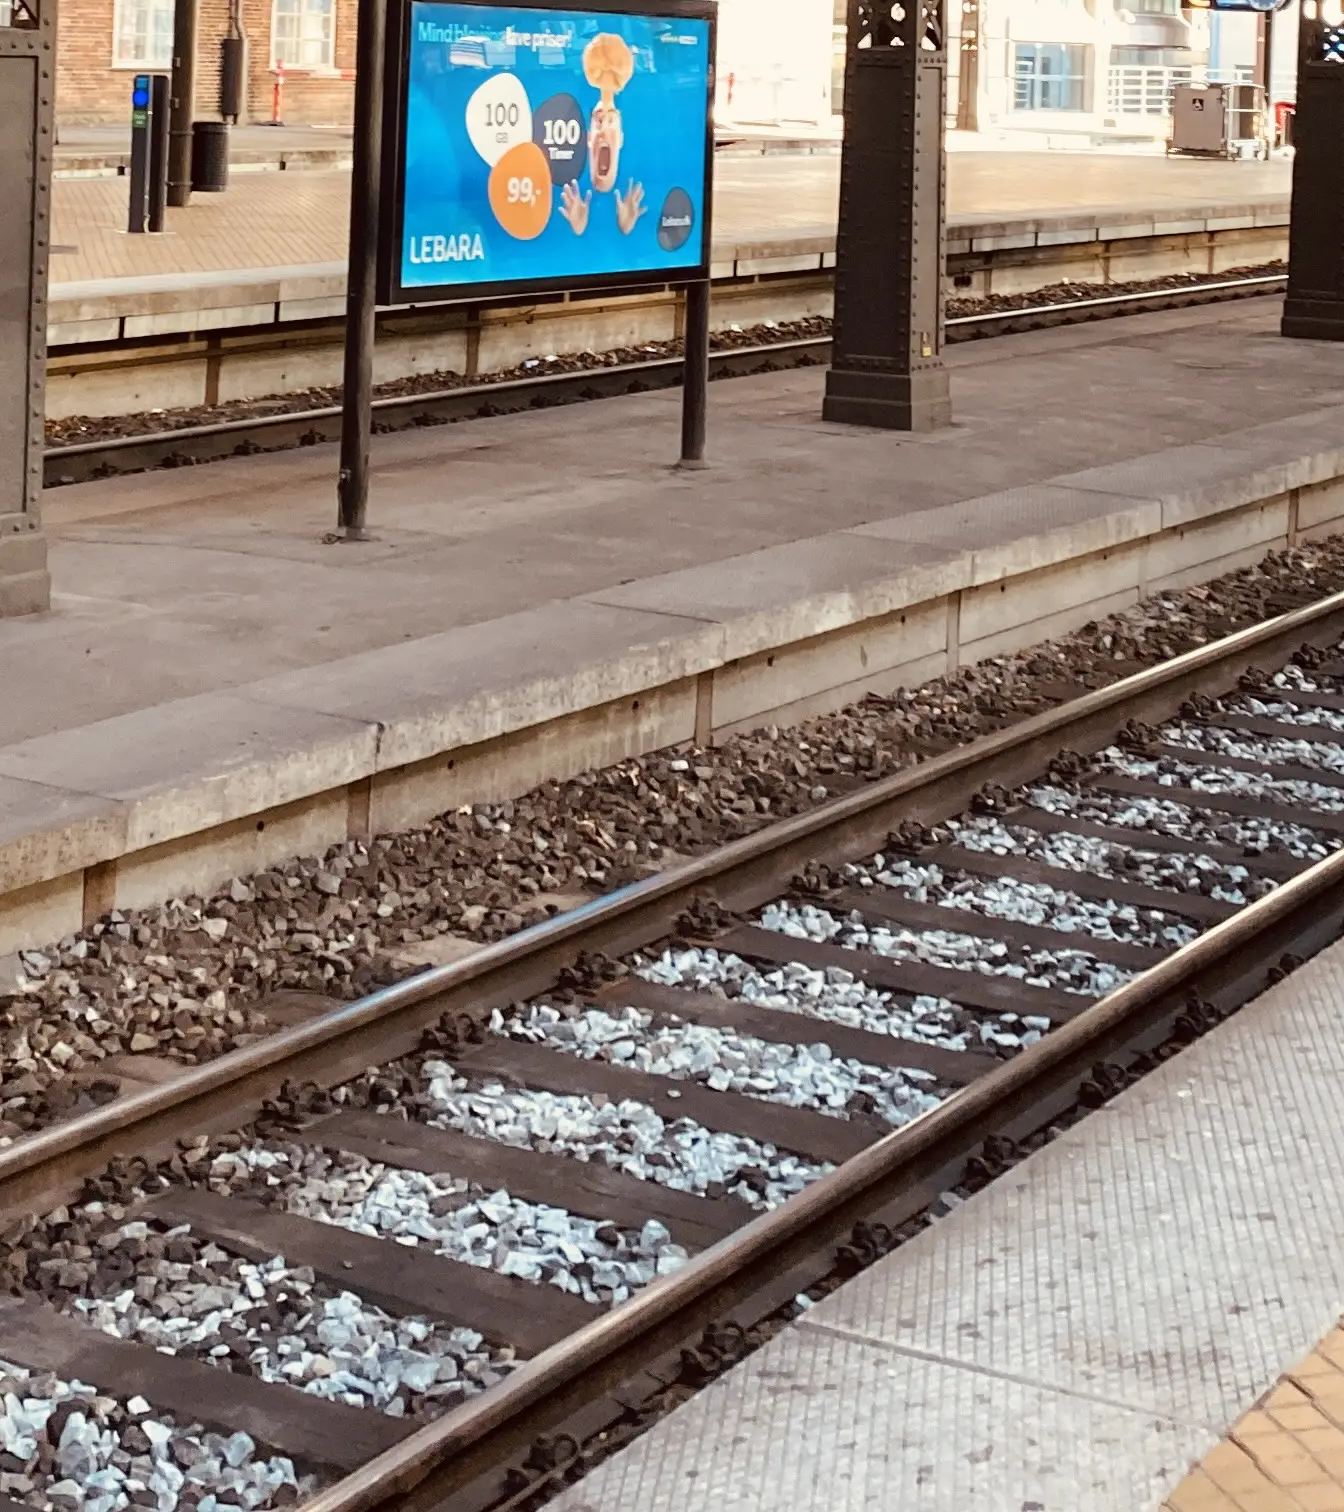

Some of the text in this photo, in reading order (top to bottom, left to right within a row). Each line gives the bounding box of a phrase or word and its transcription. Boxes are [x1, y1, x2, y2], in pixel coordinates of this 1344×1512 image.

[484, 102, 519, 127] 100
[543, 119, 581, 145] 100
[507, 176, 542, 208] 99,-
[409, 233, 485, 264] LEBARA
